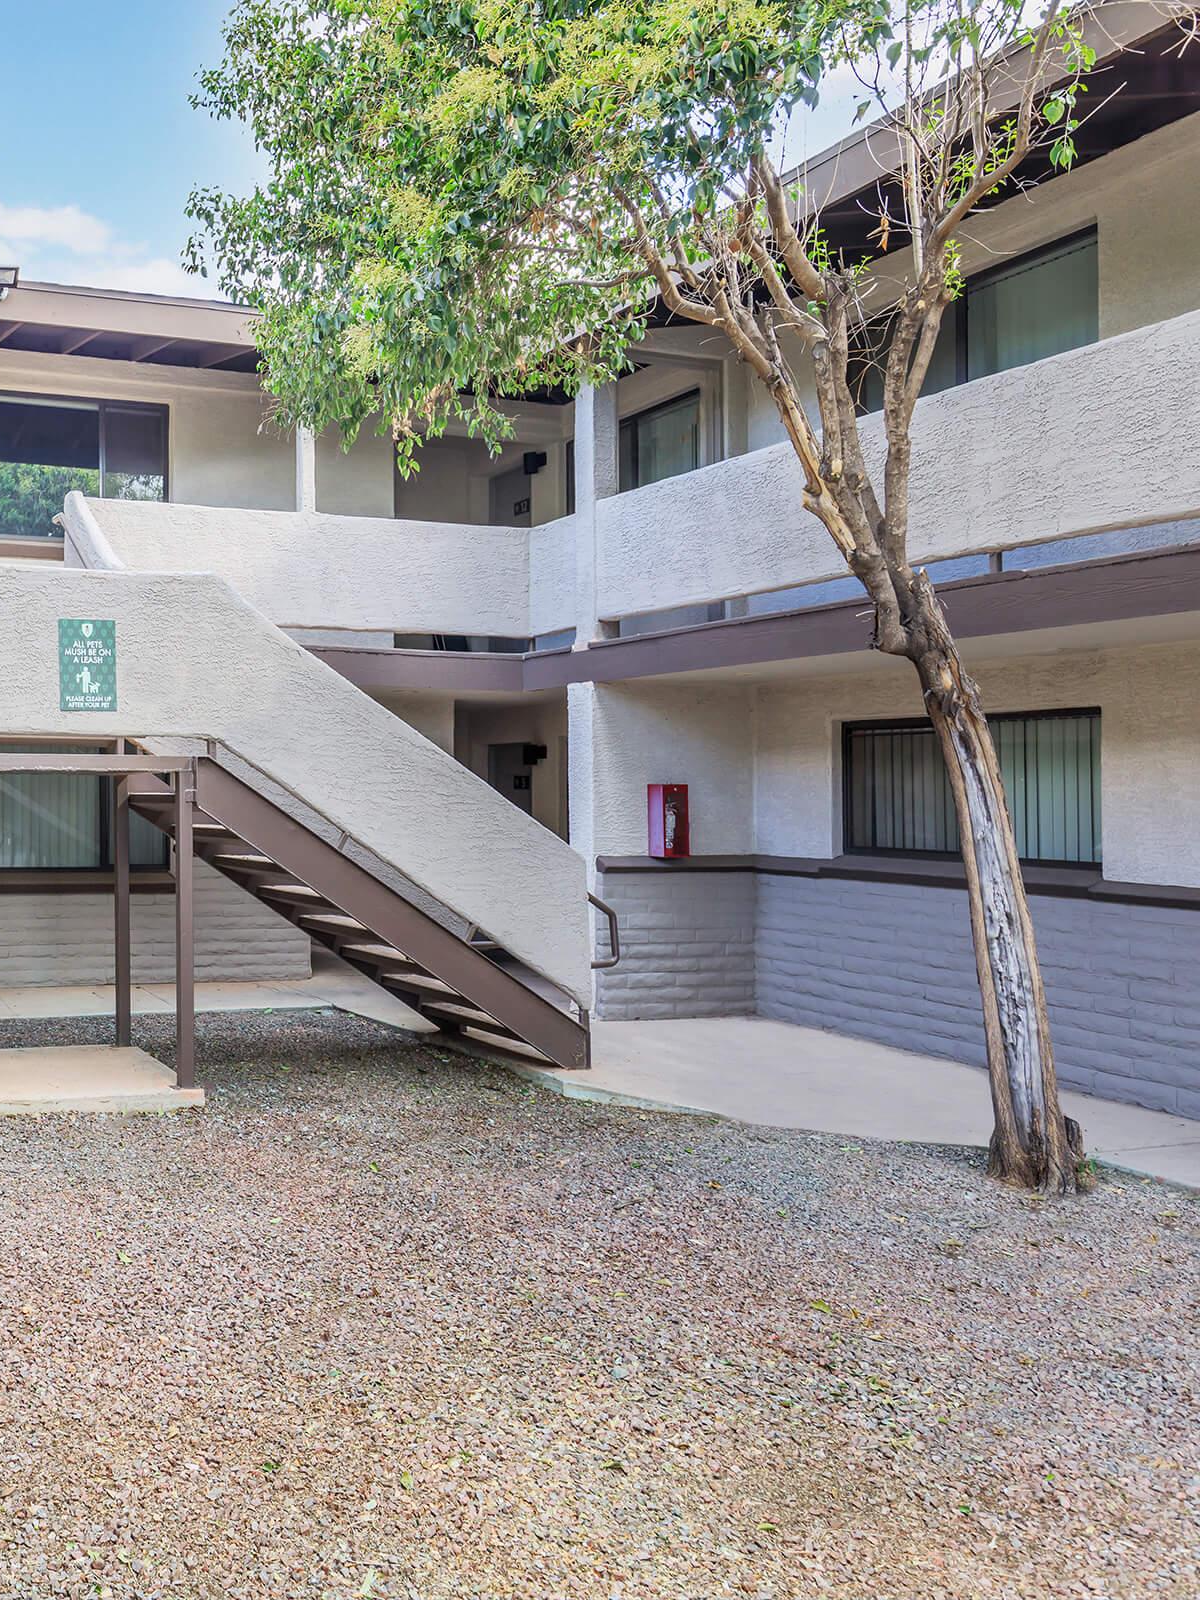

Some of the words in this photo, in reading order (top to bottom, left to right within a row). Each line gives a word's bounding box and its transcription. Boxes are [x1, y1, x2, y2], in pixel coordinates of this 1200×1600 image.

[72, 640, 85, 648] ALL
[86, 640, 103, 648] PETS
[88, 648, 97, 656] BE
[98, 648, 112, 656] ON
[72, 656, 79, 664] A
[80, 656, 103, 664] LEASH
